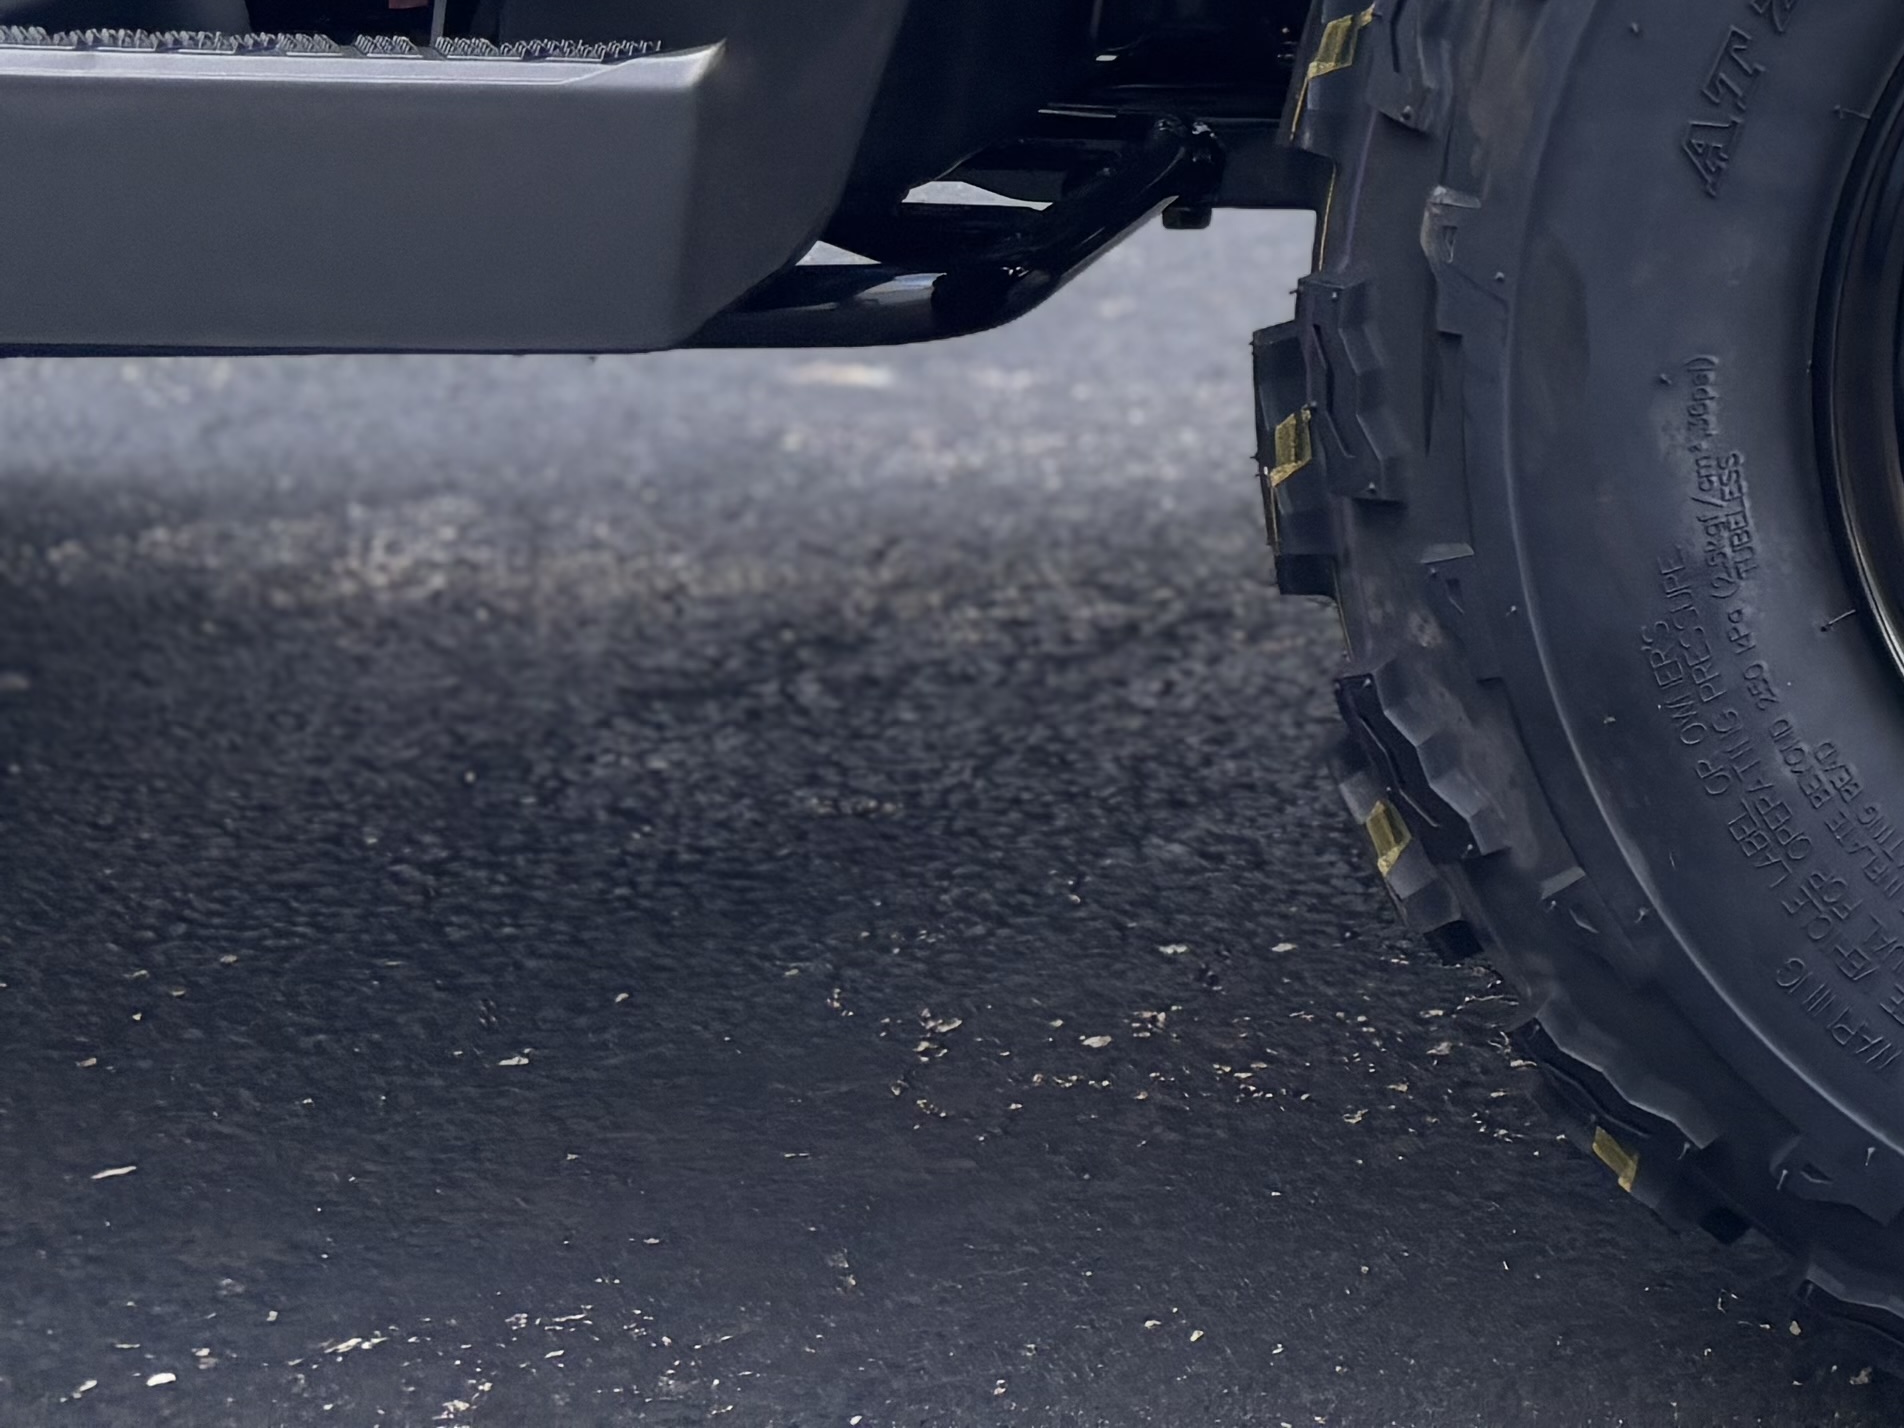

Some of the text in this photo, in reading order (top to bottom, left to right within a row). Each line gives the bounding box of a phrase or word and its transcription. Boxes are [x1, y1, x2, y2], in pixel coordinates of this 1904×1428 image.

[1711, 451, 1761, 580] TUBELESS
[1725, 608, 1757, 656] kPa
[1742, 662, 1780, 712] 250
[1694, 757, 1731, 796] OR
[1768, 718, 1836, 809] BEYOND
[1813, 741, 1864, 803] BEAD
[1727, 812, 1793, 888] LABEL
[1806, 869, 1863, 920] FOR
